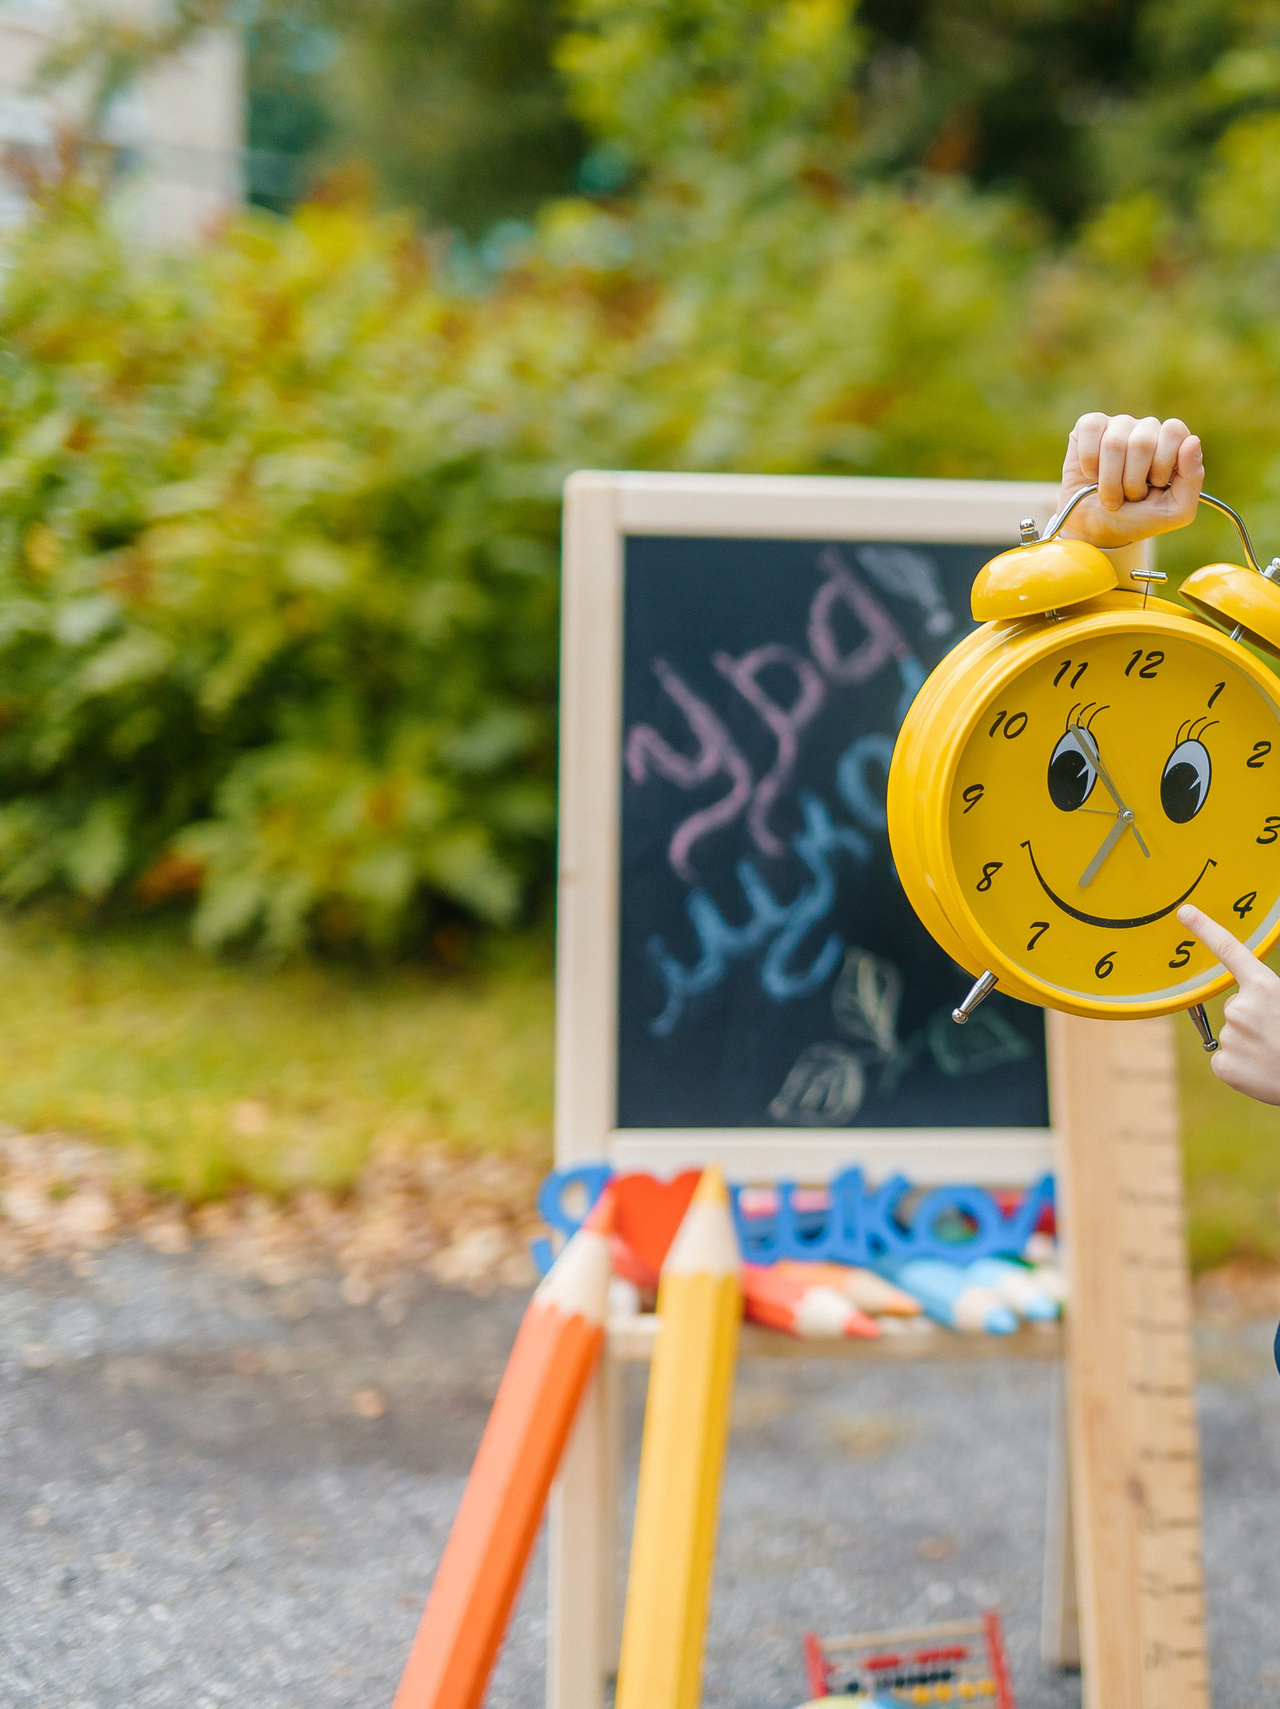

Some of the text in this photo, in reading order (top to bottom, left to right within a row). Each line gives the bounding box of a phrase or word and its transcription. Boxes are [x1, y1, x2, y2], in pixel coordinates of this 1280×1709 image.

[1053, 660, 1088, 689] 11
[1125, 650, 1164, 678] 12
[1208, 682, 1225, 708] 1
[989, 711, 1028, 739] 10
[1247, 741, 1271, 768] 2
[963, 784, 984, 813] 9
[976, 862, 1003, 892] 8
[1233, 891, 1256, 919] 4
[1027, 922, 1049, 951] 7
[1095, 952, 1117, 978] 6
[1169, 941, 1195, 968] 5
